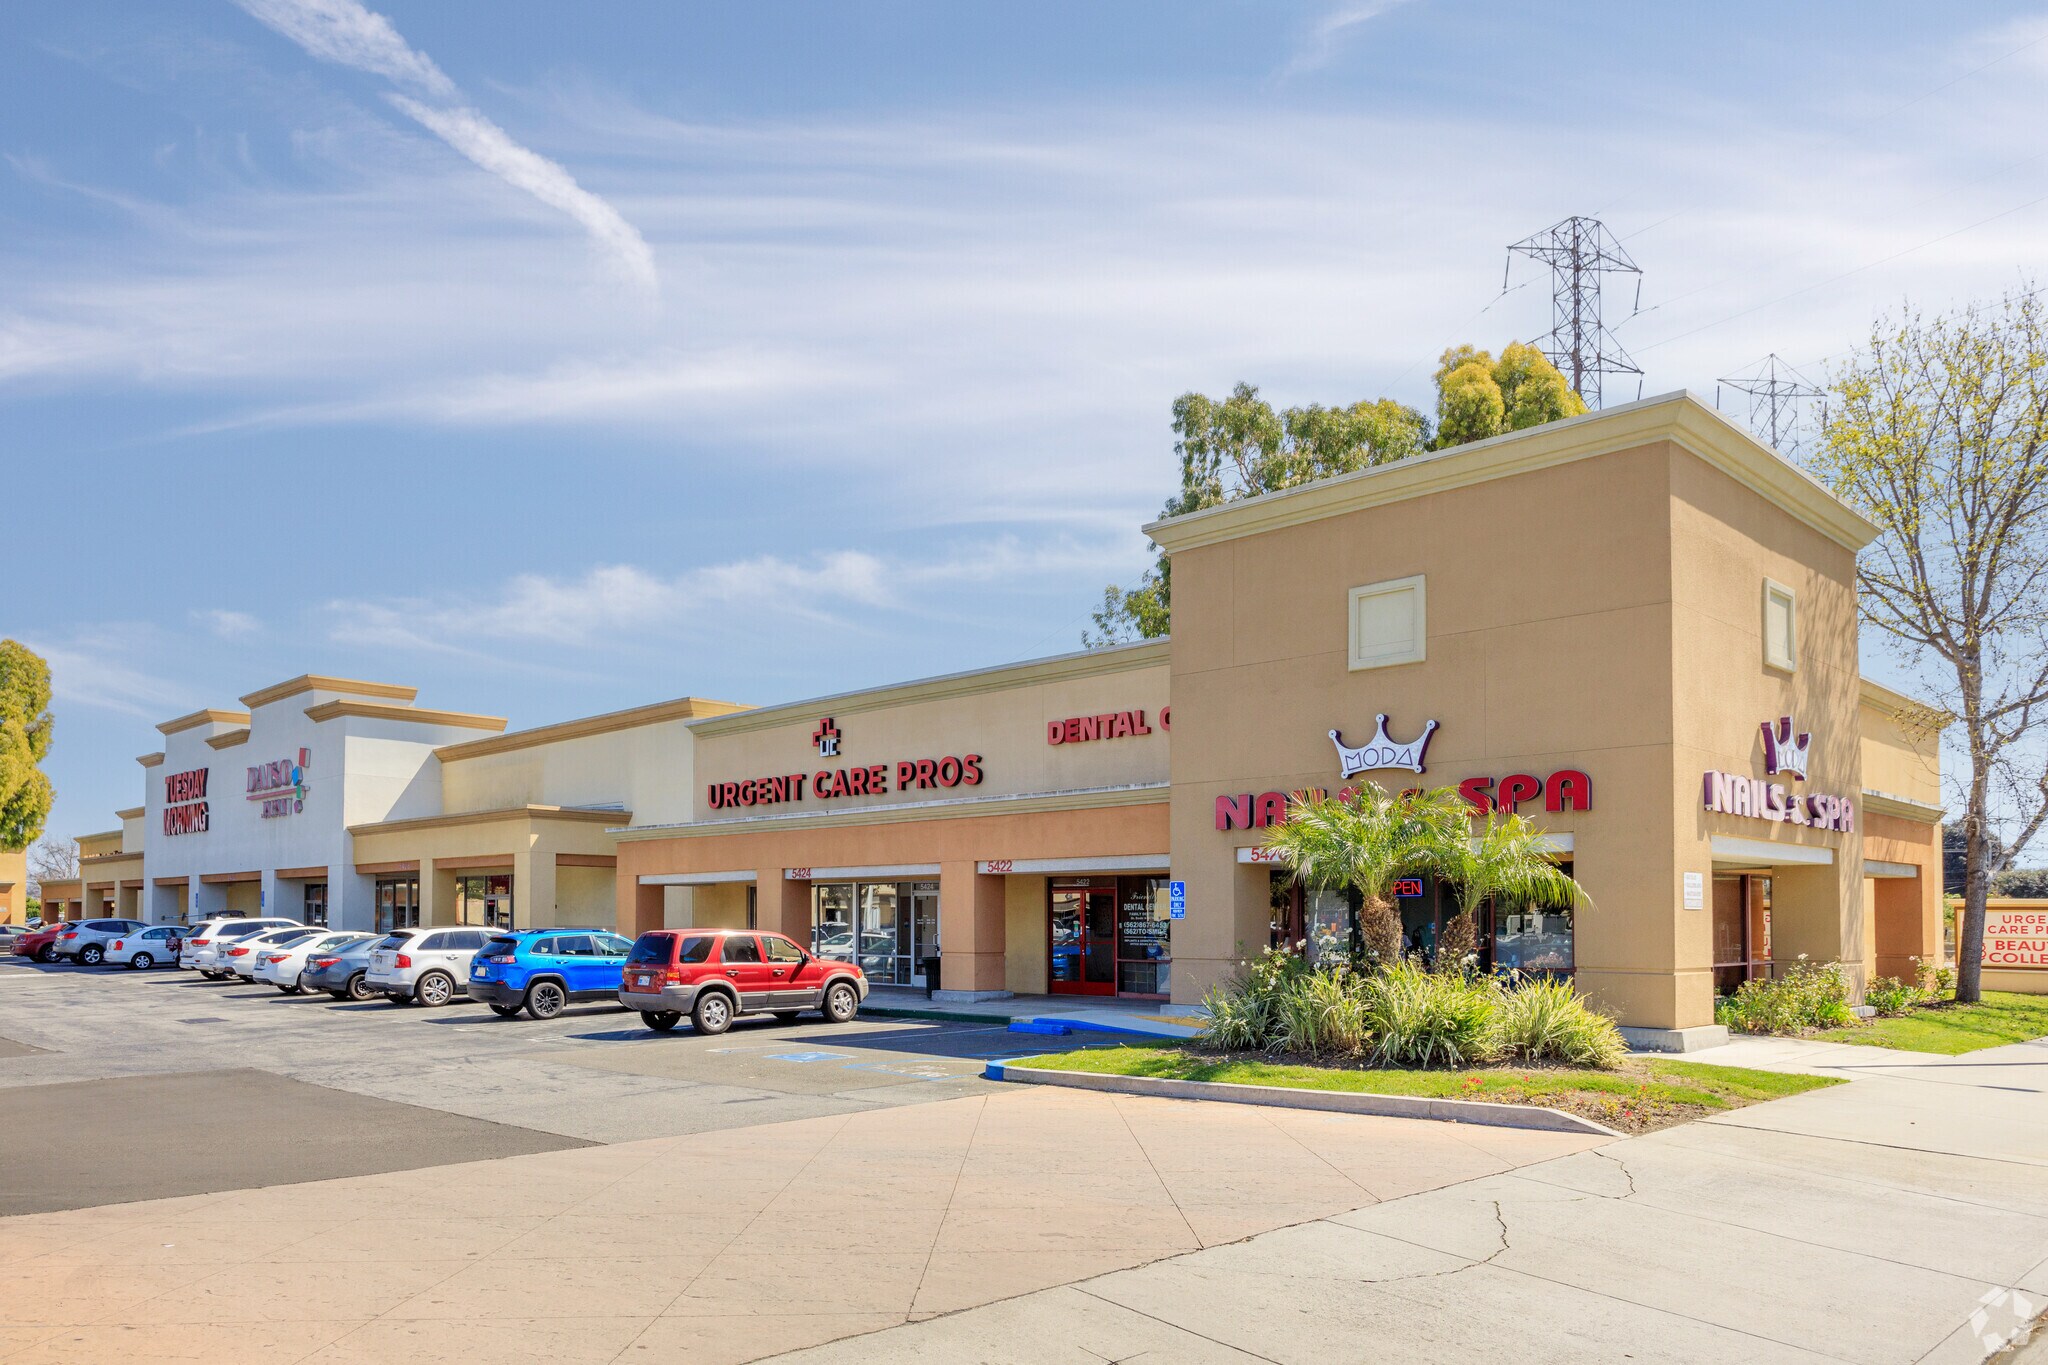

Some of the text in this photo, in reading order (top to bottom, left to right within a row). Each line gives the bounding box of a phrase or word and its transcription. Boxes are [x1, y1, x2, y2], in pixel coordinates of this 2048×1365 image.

[1047, 709, 1152, 746] DENTAL
[819, 738, 841, 758] UC
[1345, 747, 1414, 771] MODA
[165, 767, 209, 804] TUESDAY
[247, 759, 293, 792] DAISO
[707, 754, 984, 810] URGENT CARE PROS
[1458, 769, 1593, 816] SPA
[1703, 769, 1785, 822] NAILS
[1807, 792, 1855, 834] SPA
[163, 801, 209, 837] MORNING
[791, 867, 812, 880] 5424
[987, 860, 1013, 873] 5422
[1392, 880, 1422, 896] PEN
[1123, 903, 1145, 911] DENTAL
[1987, 925, 2048, 934] CARE P
[2002, 915, 2047, 924] URGE
[1988, 952, 2048, 964] COLLE
